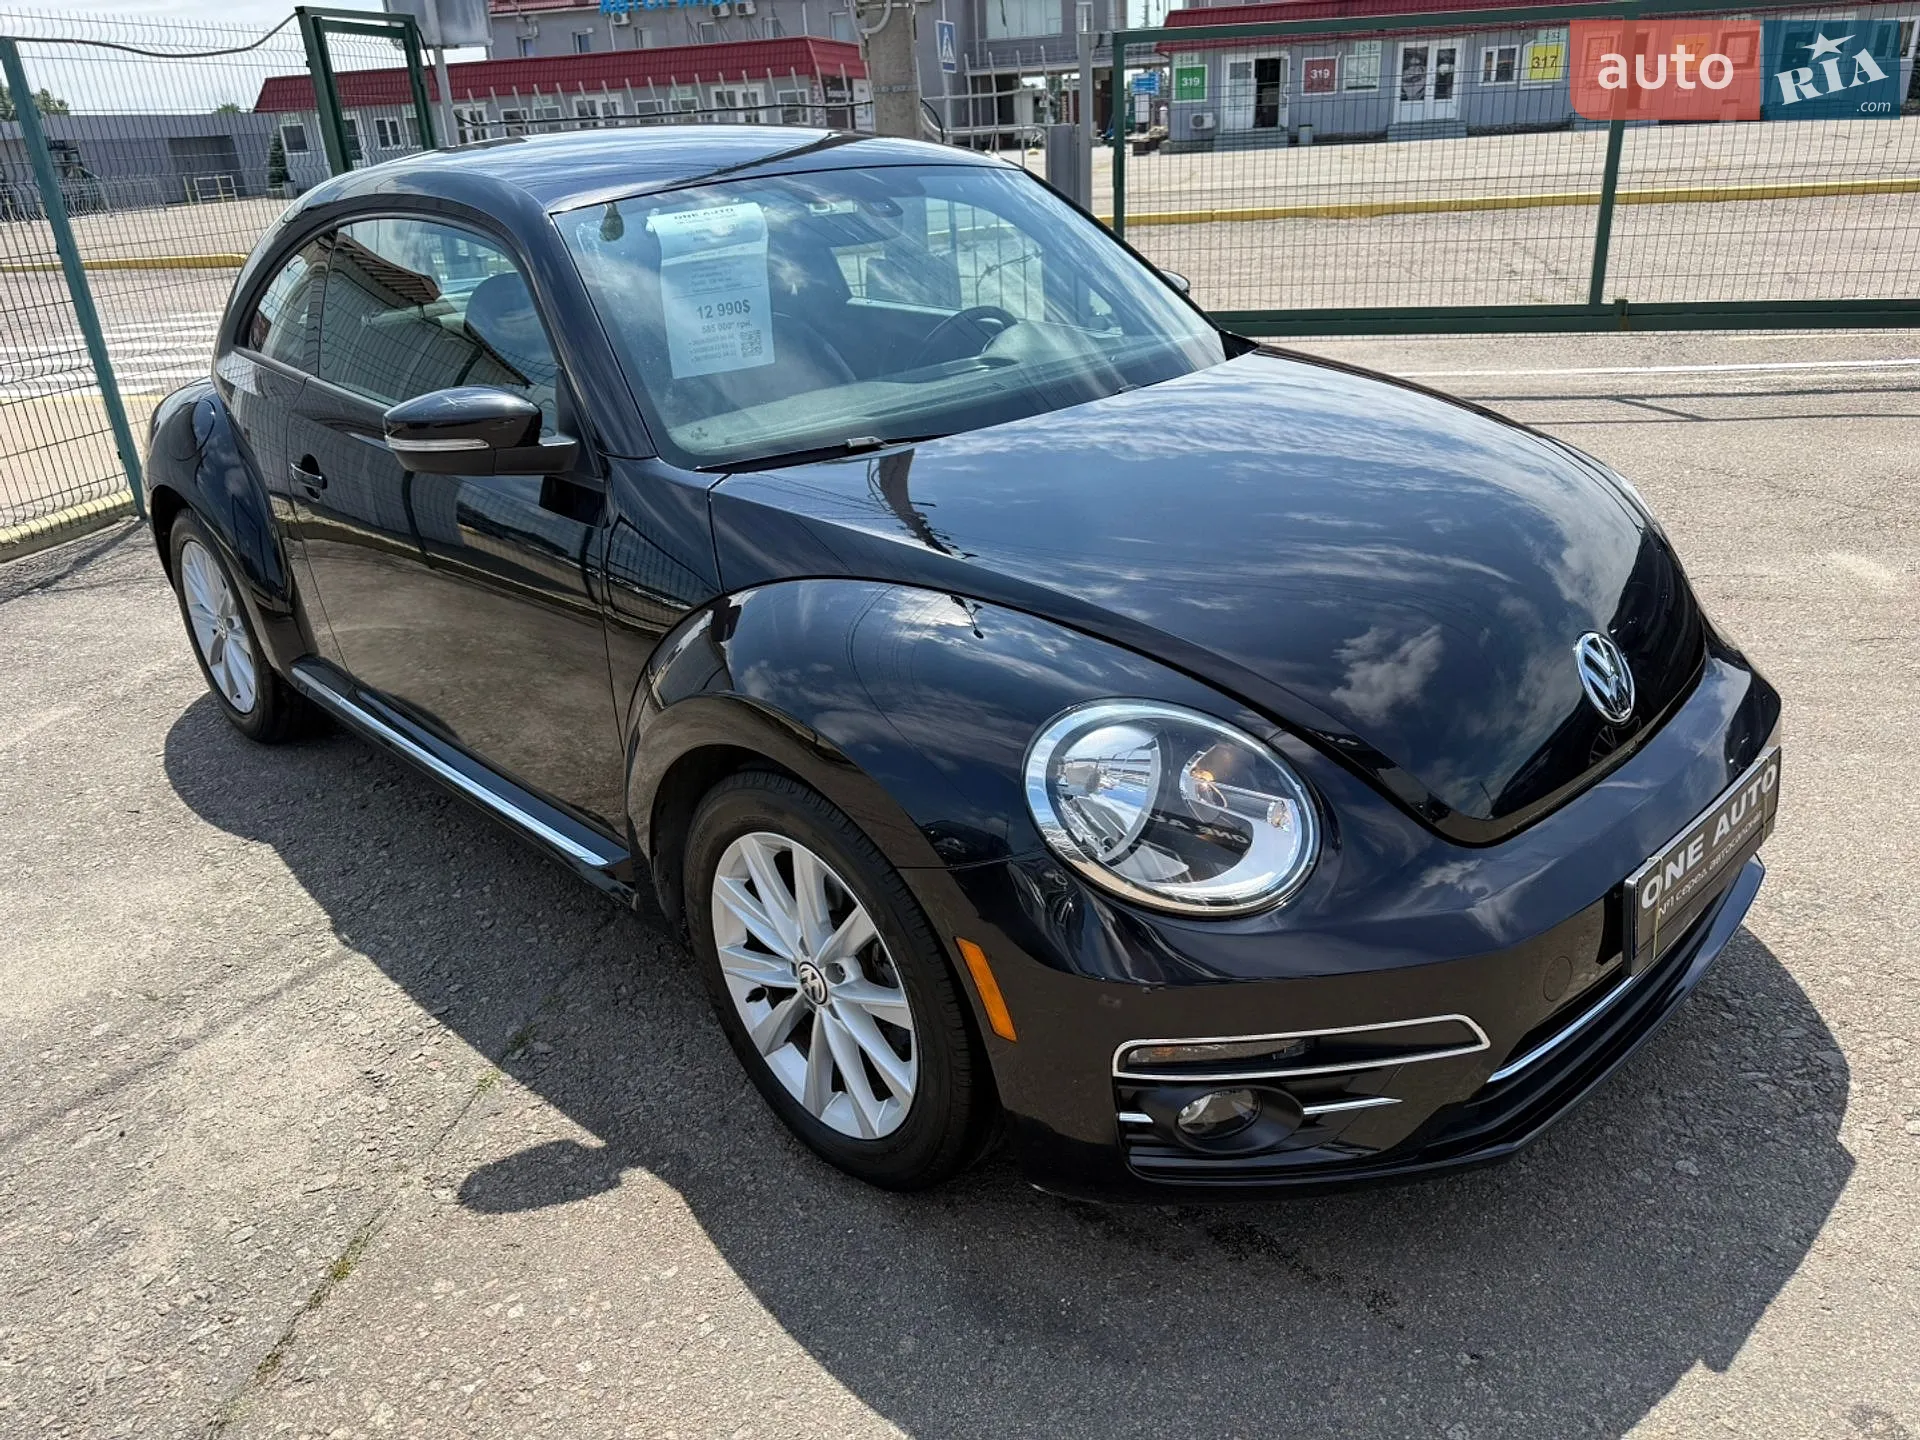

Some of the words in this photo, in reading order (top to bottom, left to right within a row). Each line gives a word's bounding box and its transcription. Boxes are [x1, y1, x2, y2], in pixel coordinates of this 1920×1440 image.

[1532, 55, 1558, 69] 317
[1310, 68, 1330, 79] 319
[1181, 77, 1200, 87] 319
[696, 305, 713, 319] 12
[717, 299, 751, 317] 990$
[1641, 834, 1704, 909] ONE
[1712, 764, 1777, 847] AUTO
